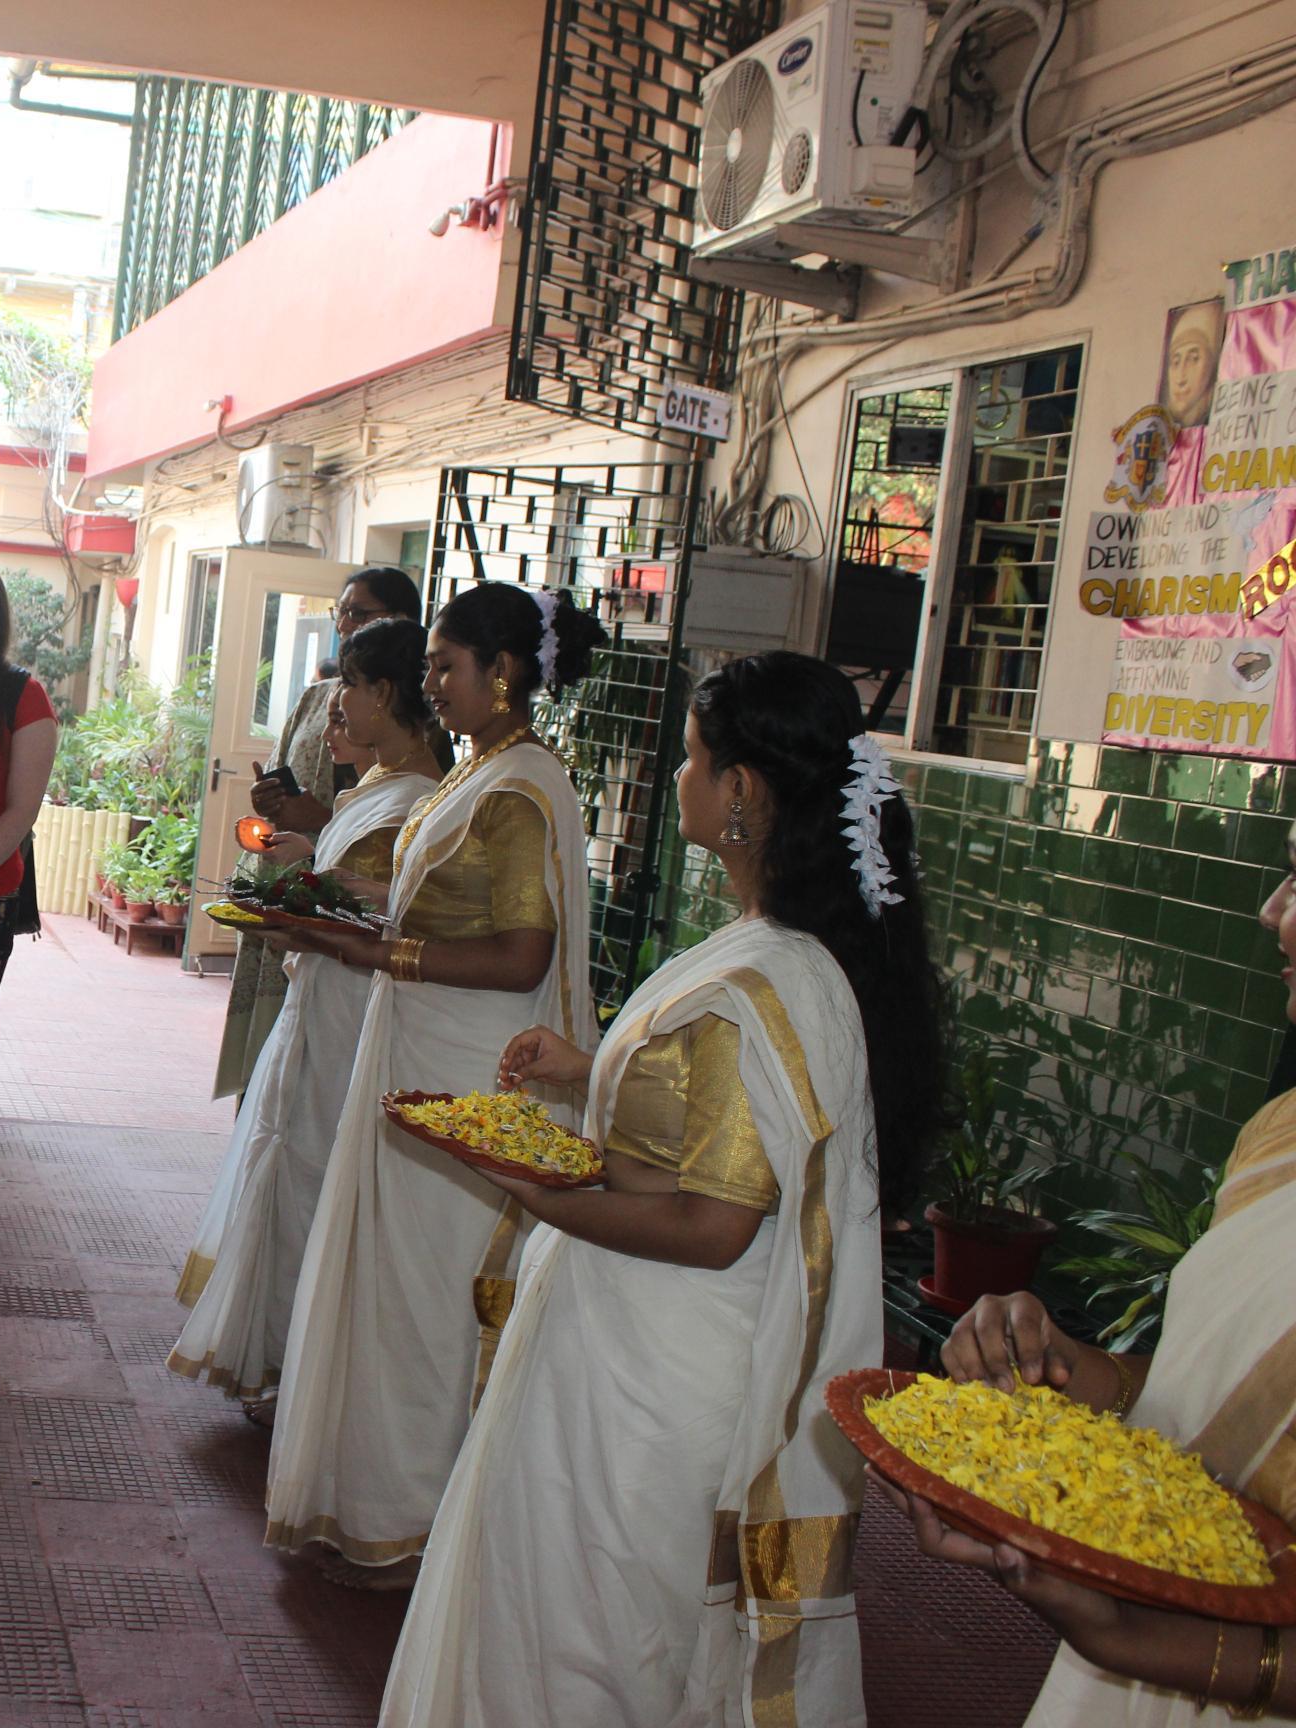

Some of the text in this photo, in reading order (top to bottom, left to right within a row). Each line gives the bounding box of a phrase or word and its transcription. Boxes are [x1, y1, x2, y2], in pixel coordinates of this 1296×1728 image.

[1225, 248, 1296, 304] THA
[665, 390, 711, 430] GATE
[1214, 375, 1278, 415] BEING
[1212, 408, 1277, 447] AGENT
[1202, 445, 1296, 492] CHAN
[1096, 504, 1220, 542] OWNING AND
[1087, 537, 1229, 570] DEVELOPING THE
[1079, 572, 1242, 617] CHARISM
[1114, 640, 1223, 665] EMBRACING AND
[1116, 667, 1191, 691] AFFIRMING
[1104, 692, 1270, 746] DIVERSITY
